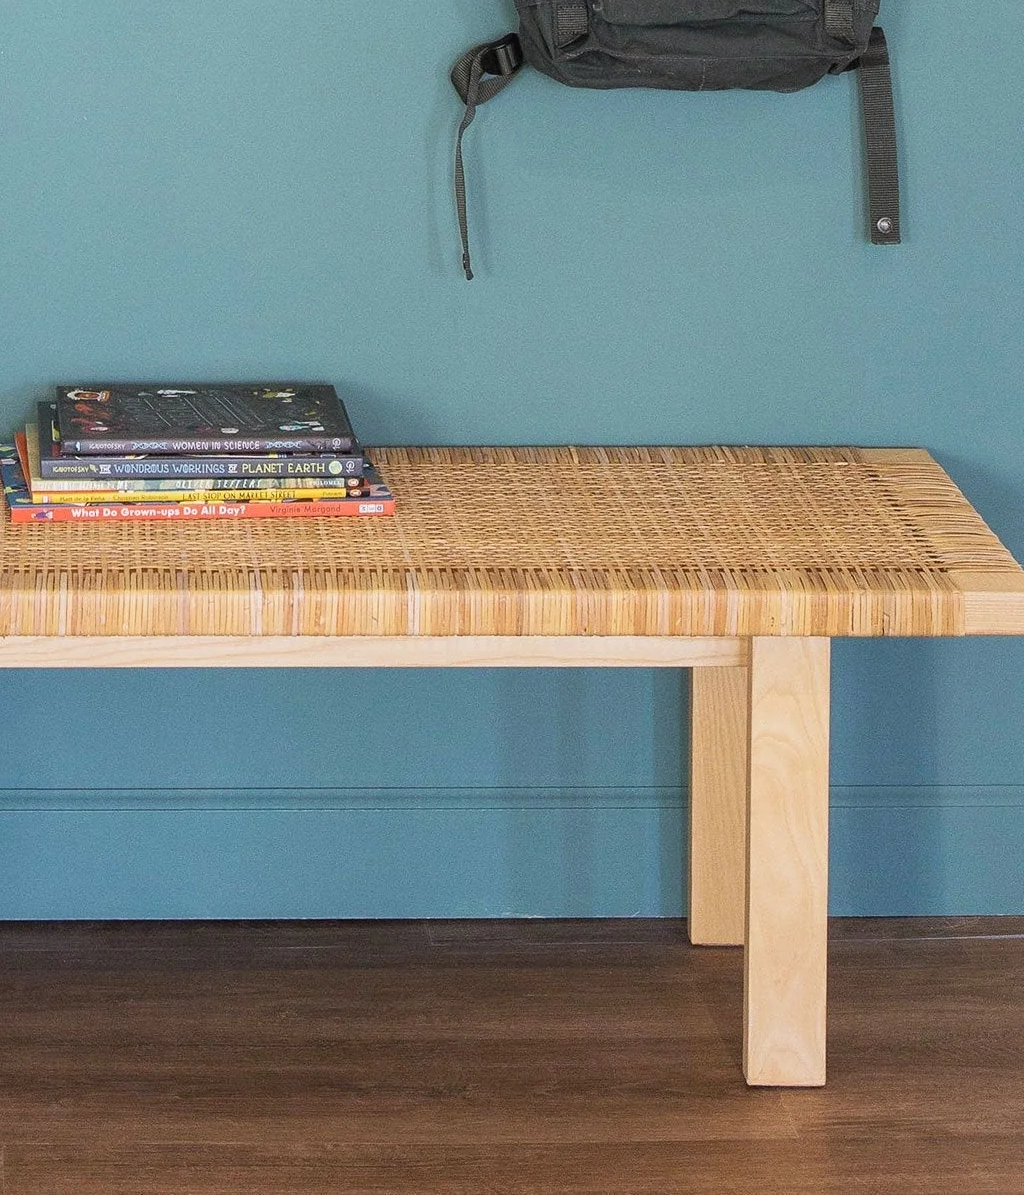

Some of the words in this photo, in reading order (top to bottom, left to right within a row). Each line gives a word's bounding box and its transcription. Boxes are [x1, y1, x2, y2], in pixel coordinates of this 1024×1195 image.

[173, 441, 208, 450] WOMEN
[212, 441, 221, 449] IN
[224, 441, 260, 450] SCIENCE
[99, 464, 112, 474] THE
[114, 463, 169, 473] WONDROUS
[173, 463, 225, 473] WORKINGS
[228, 463, 237, 473] OF
[242, 463, 284, 473] PLANET
[288, 463, 325, 473] EARTH
[176, 479, 213, 489] OLIVER
[217, 479, 262, 489] JEFFERS
[203, 492, 222, 500] STOP
[239, 491, 268, 499] MARKET
[71, 508, 100, 517] What
[103, 507, 118, 516] Do
[121, 506, 180, 517] Grown-ups
[183, 506, 198, 515] Do
[201, 505, 216, 515] All
[219, 505, 246, 516] Day?
[270, 505, 301, 513] Virginie
[303, 504, 341, 514] Margand
